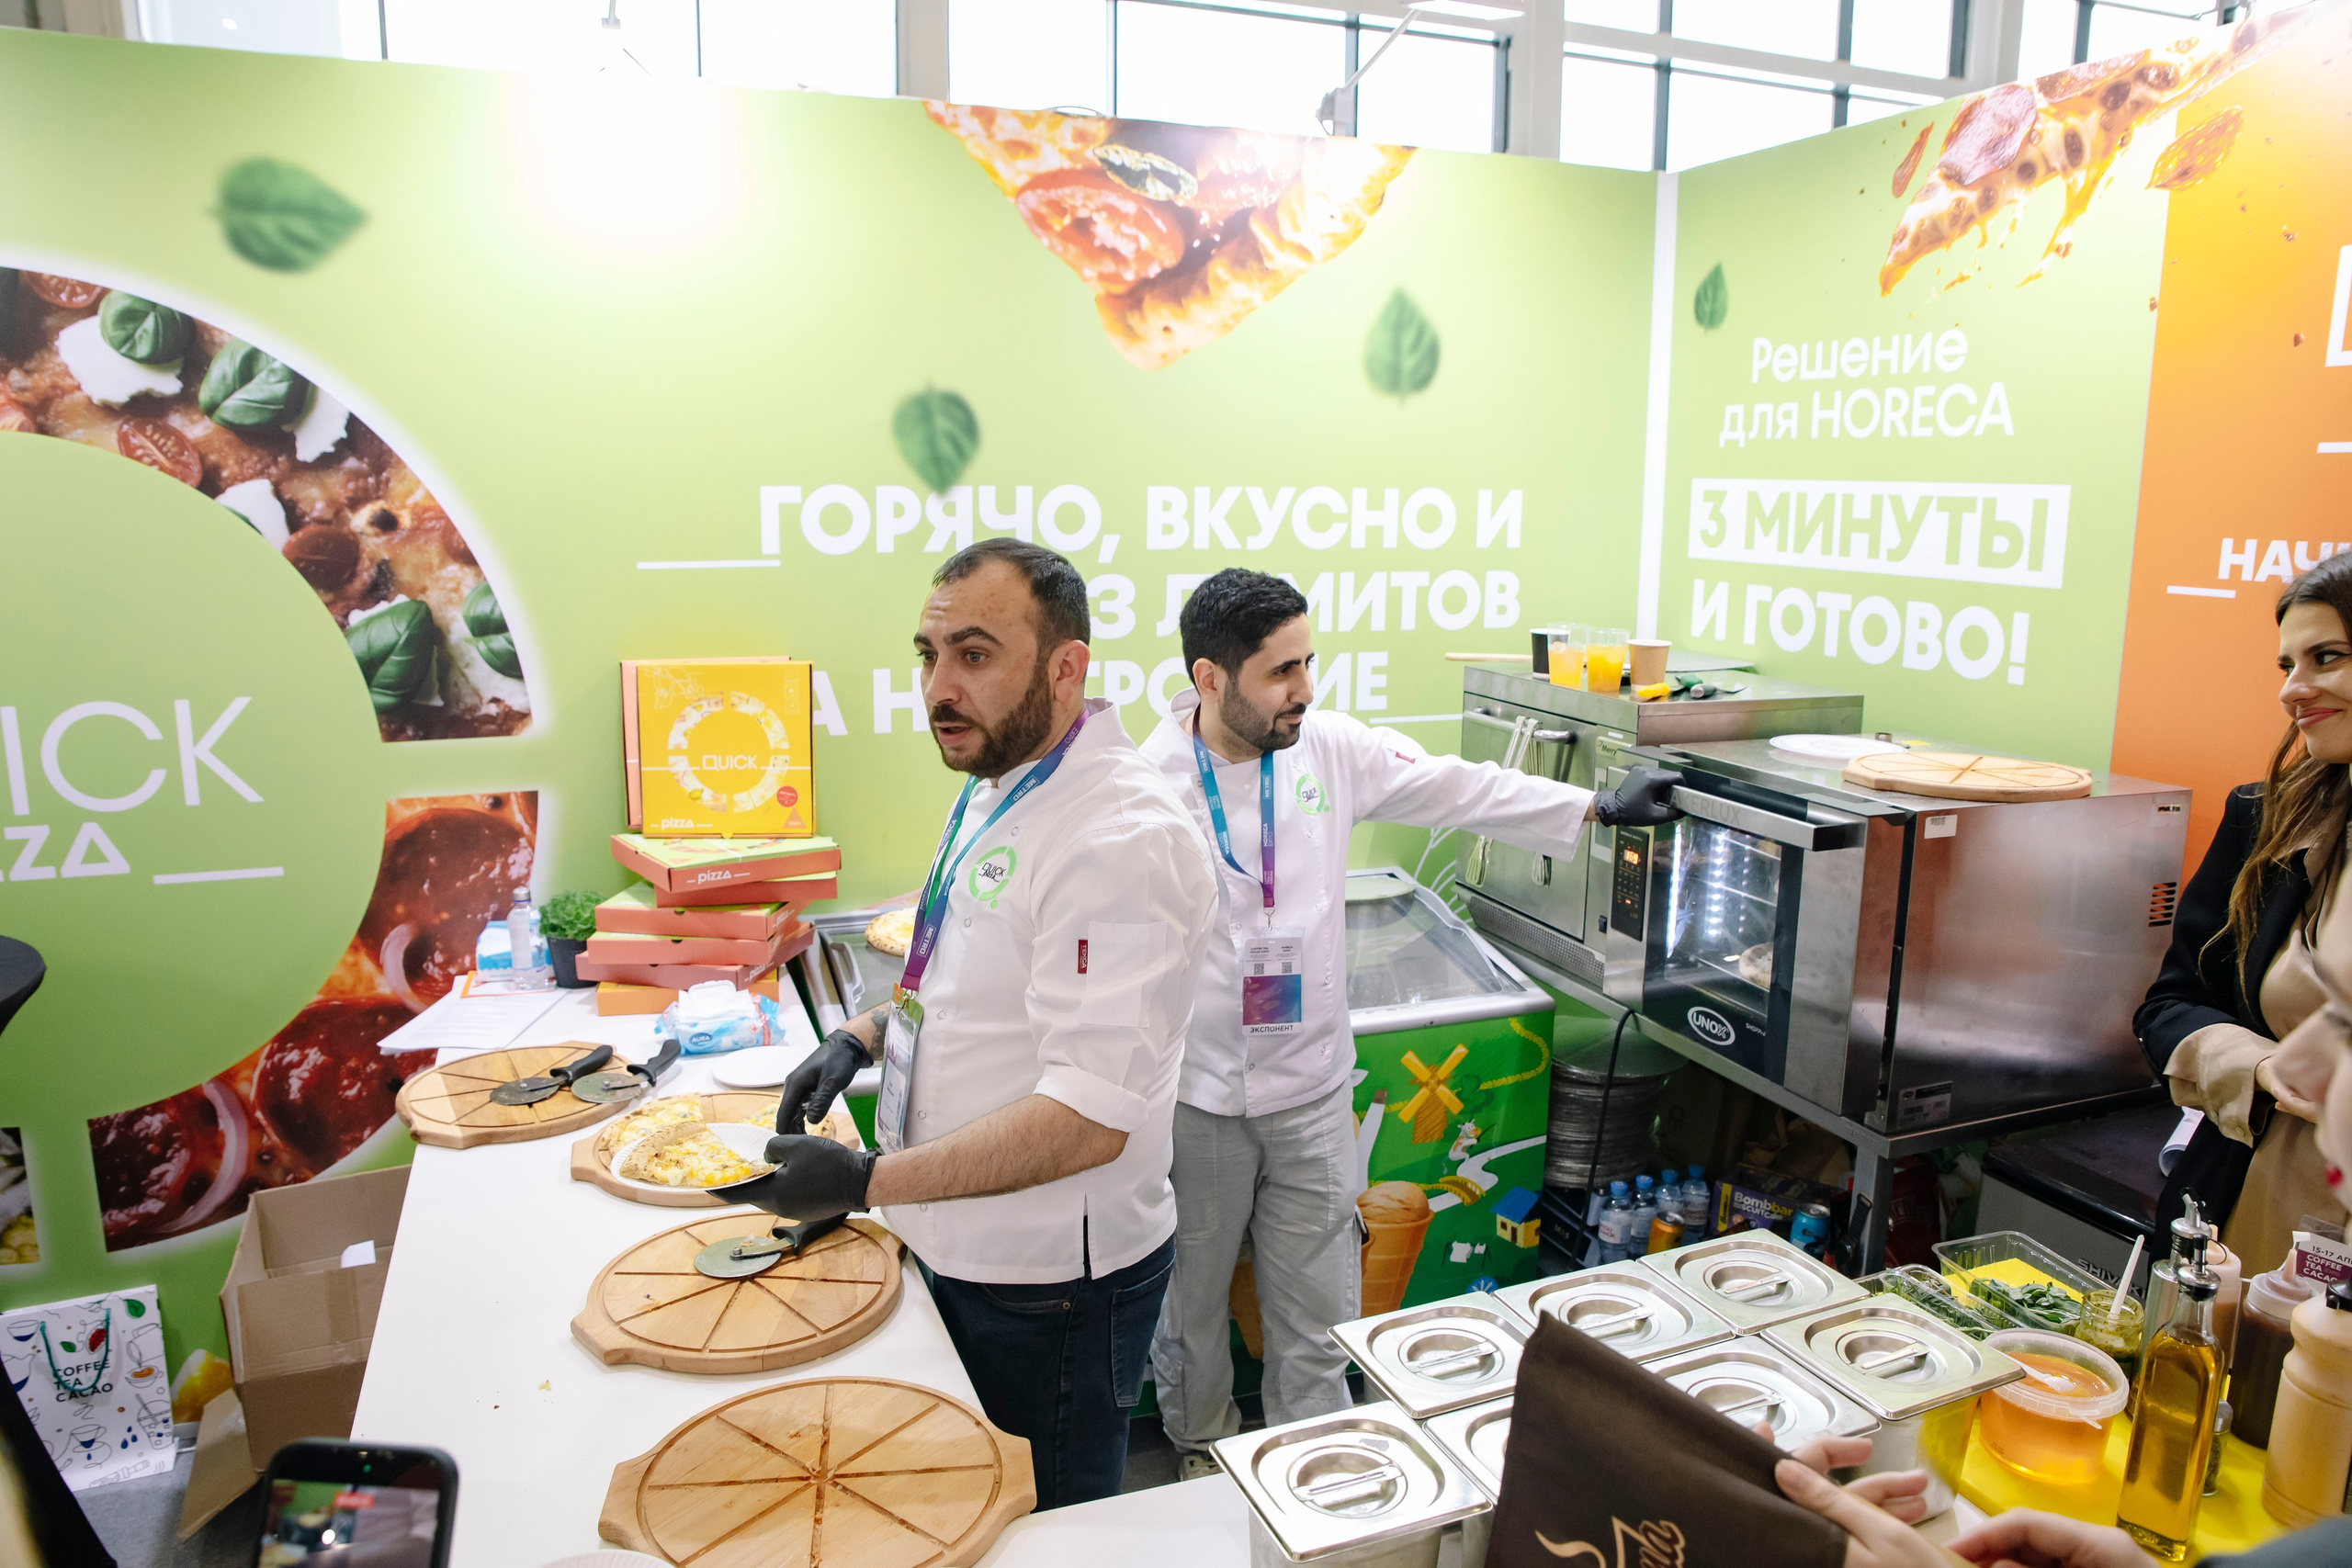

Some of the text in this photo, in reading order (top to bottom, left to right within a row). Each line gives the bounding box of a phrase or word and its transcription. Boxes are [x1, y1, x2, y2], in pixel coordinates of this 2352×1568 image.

[1752, 329, 1968, 384] Решение
[1719, 382, 2015, 448] для HORECA
[760, 484, 1523, 563] ГОРЯЧО, ВКУСНО И
[1699, 489, 2050, 573] 3 МИНУТЫ
[2218, 537, 2352, 583] НАЧ
[1157, 570, 1521, 637] ЛМИТОВ
[1690, 579, 2030, 685] И ГОТОВО!
[702, 754, 758, 772] QUICK
[1199, 750, 1208, 772] METRO
[1012, 776, 1037, 802] METRO
[1670, 789, 1740, 825] AKERLUX
[1222, 831, 1230, 855] HORECA
[919, 927, 935, 954] METRO
[1250, 1025, 1294, 1033] ЭКСПОНЕНТ
[1692, 1011, 1727, 1039] UNOX
[2305, 1260, 2323, 1271] TEA
[2306, 1255, 2342, 1271] COFFEE
[2312, 1246, 2352, 1265] 15-17 АП
[2077, 1258, 2145, 1299] SHIVKI
[56, 1382, 114, 1403] CACAO
